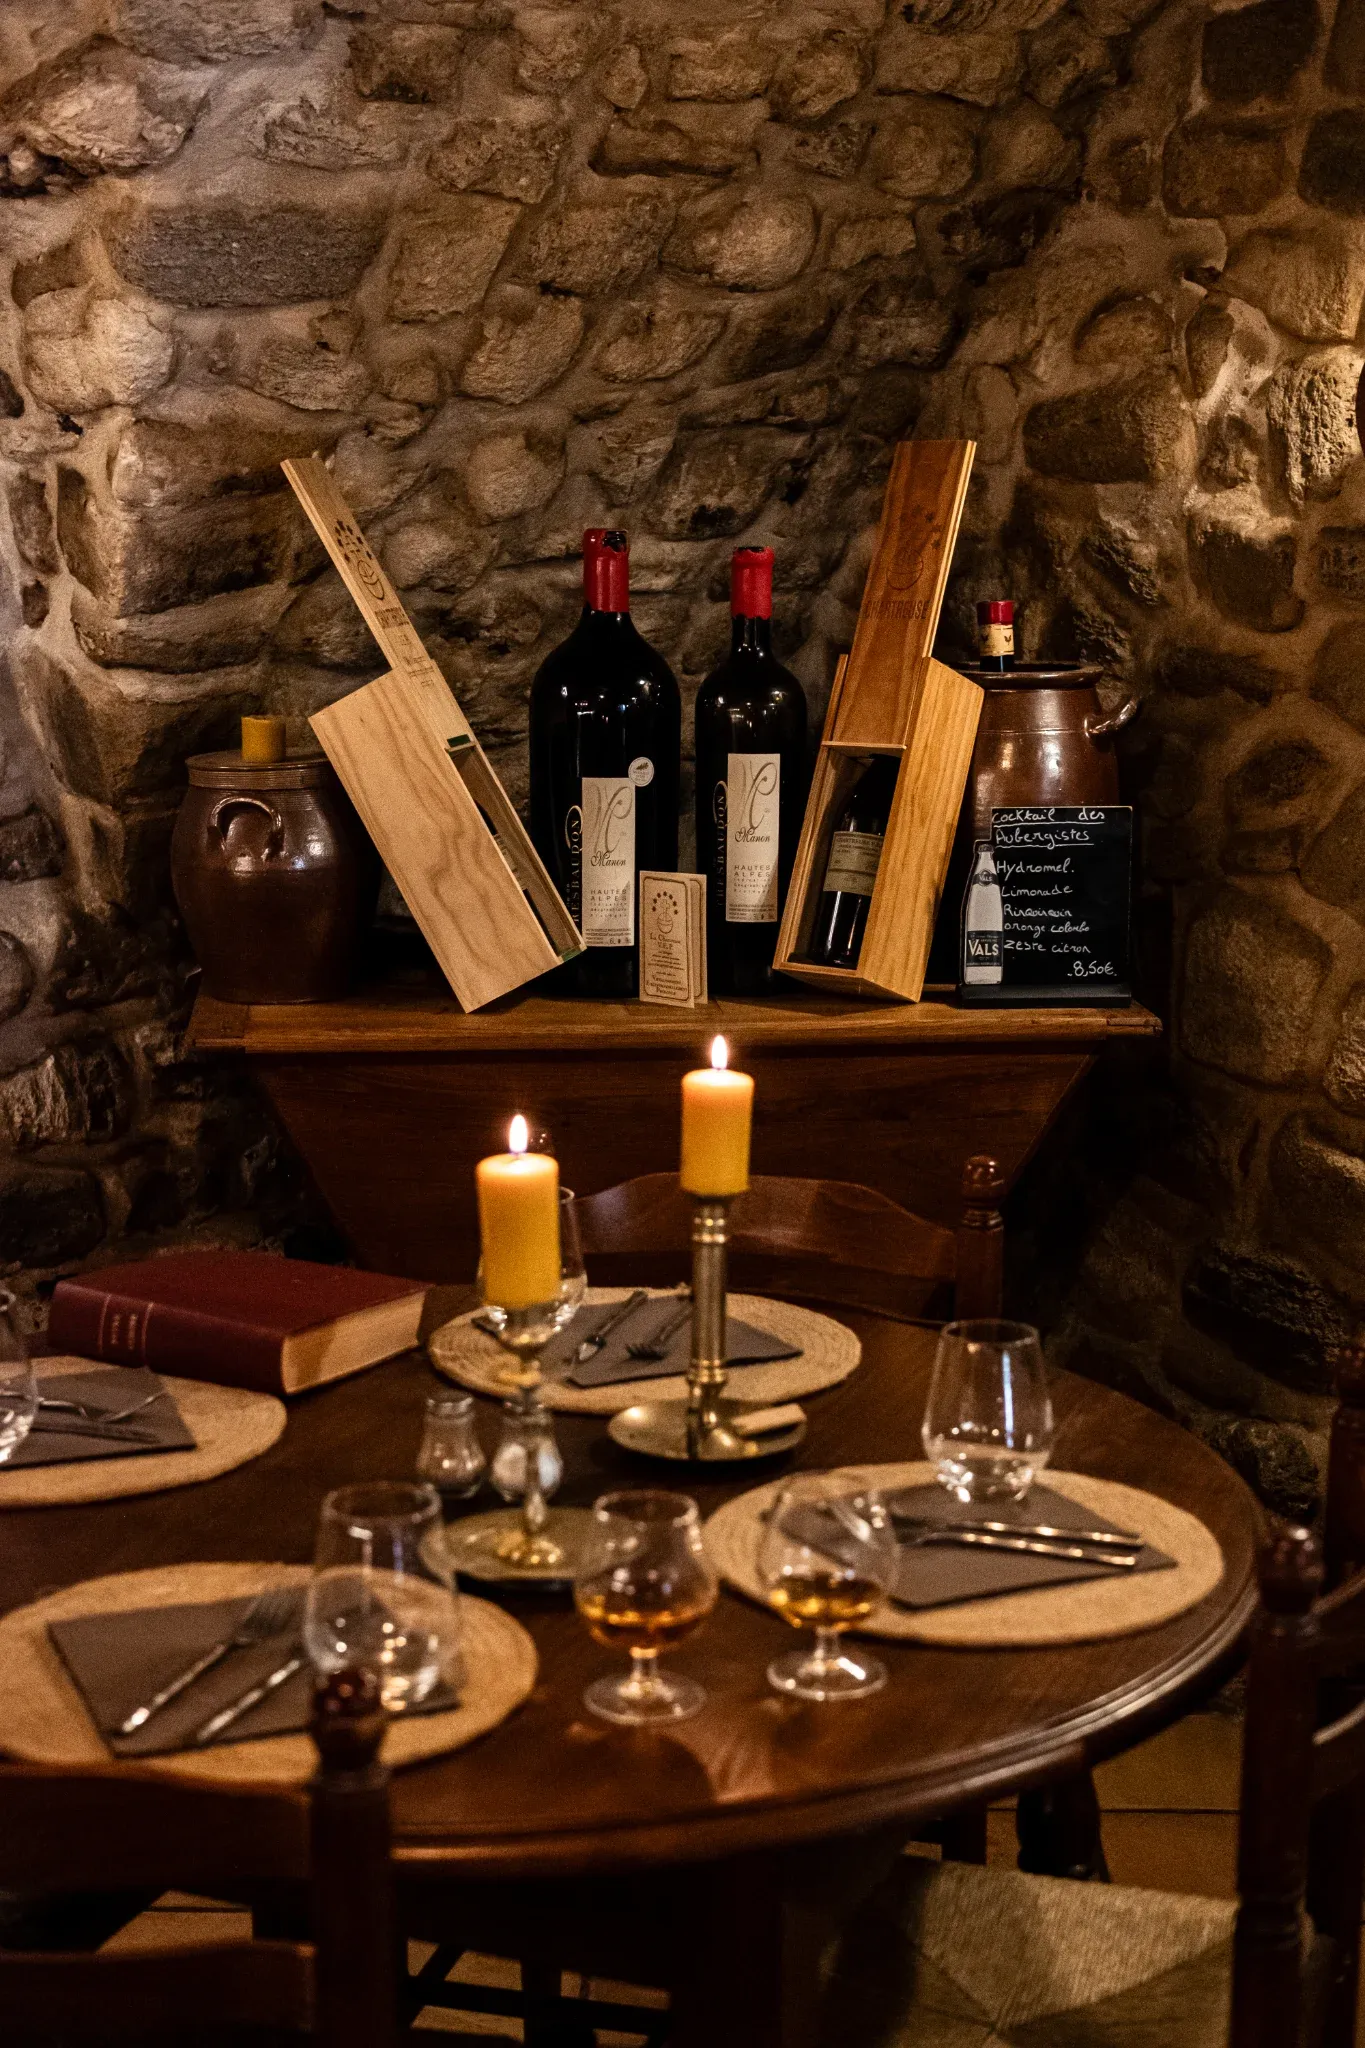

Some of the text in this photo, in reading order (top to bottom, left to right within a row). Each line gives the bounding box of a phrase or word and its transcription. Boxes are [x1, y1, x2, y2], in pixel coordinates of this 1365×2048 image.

[1078, 807, 1105, 821] des
[734, 827, 770, 843] Manon
[996, 827, 1090, 850] Aubergistes
[590, 851, 627, 867] Manon
[571, 820, 580, 922] RESBAUDON
[1002, 885, 1074, 897] Limonade
[1050, 920, 1090, 933] colombo
[968, 938, 999, 956] VALS
[1051, 942, 1092, 954] citron
